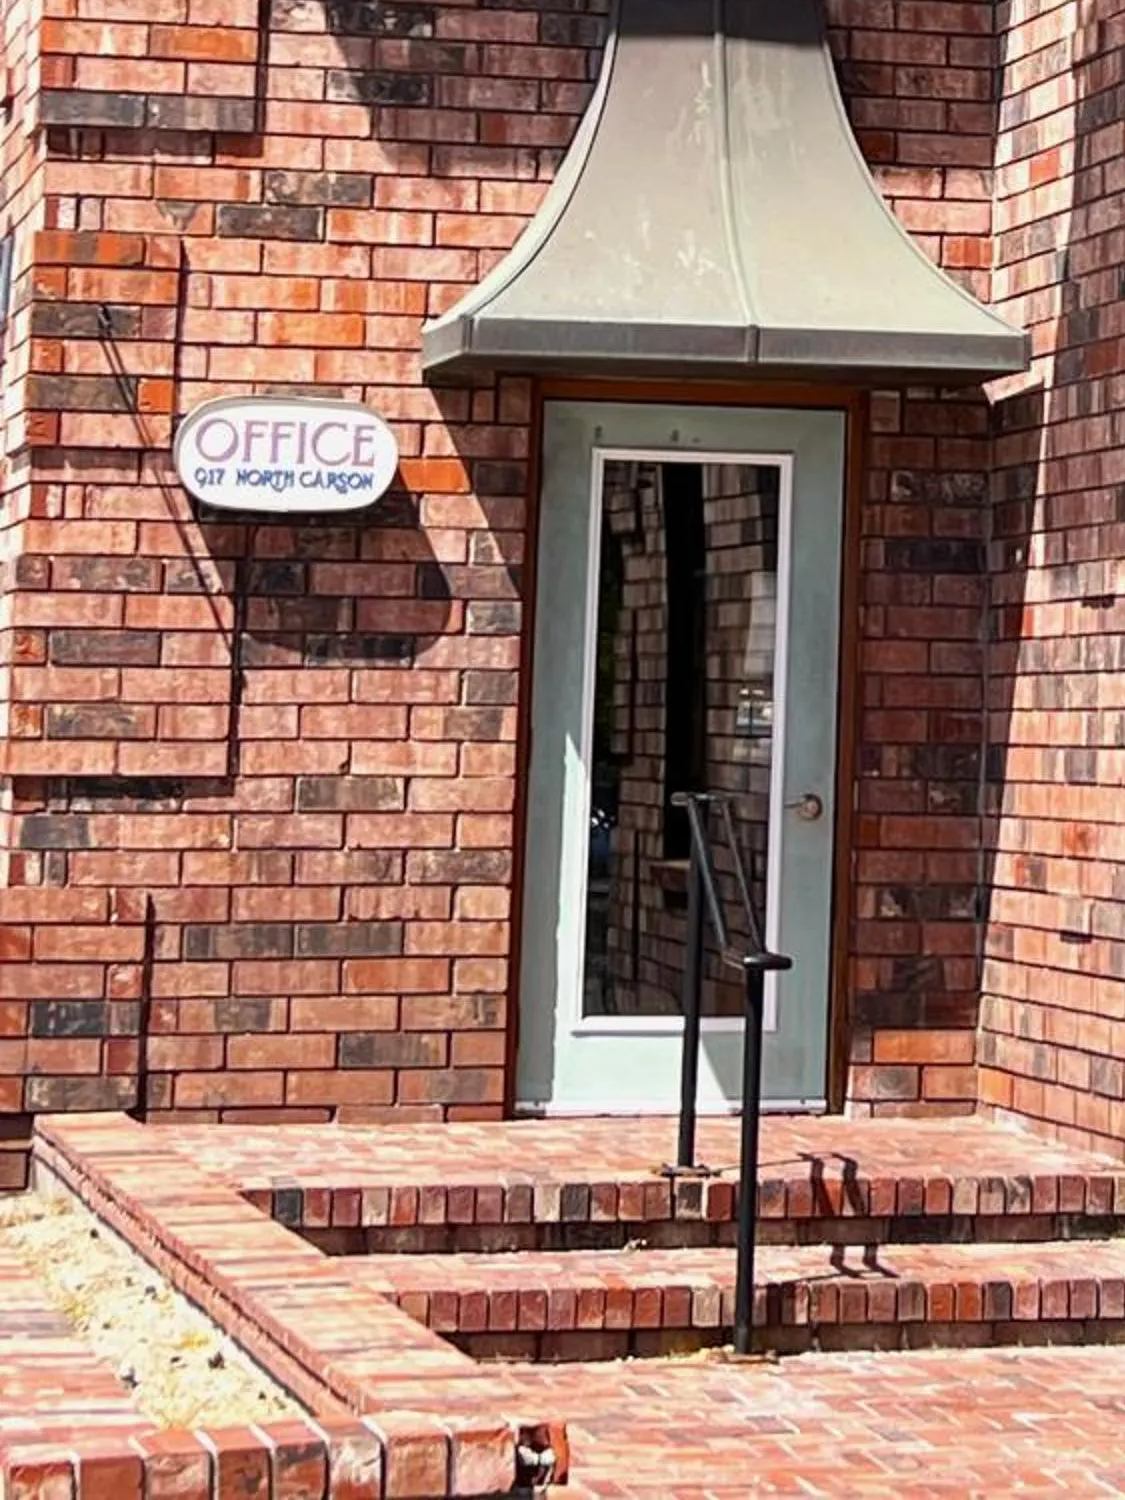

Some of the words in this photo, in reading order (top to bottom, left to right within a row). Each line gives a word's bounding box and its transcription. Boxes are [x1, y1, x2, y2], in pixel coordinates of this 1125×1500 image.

[195, 417, 377, 467] OFFICE
[194, 467, 226, 488] 917
[236, 469, 295, 493] NORTH
[299, 469, 374, 494] CARSON
